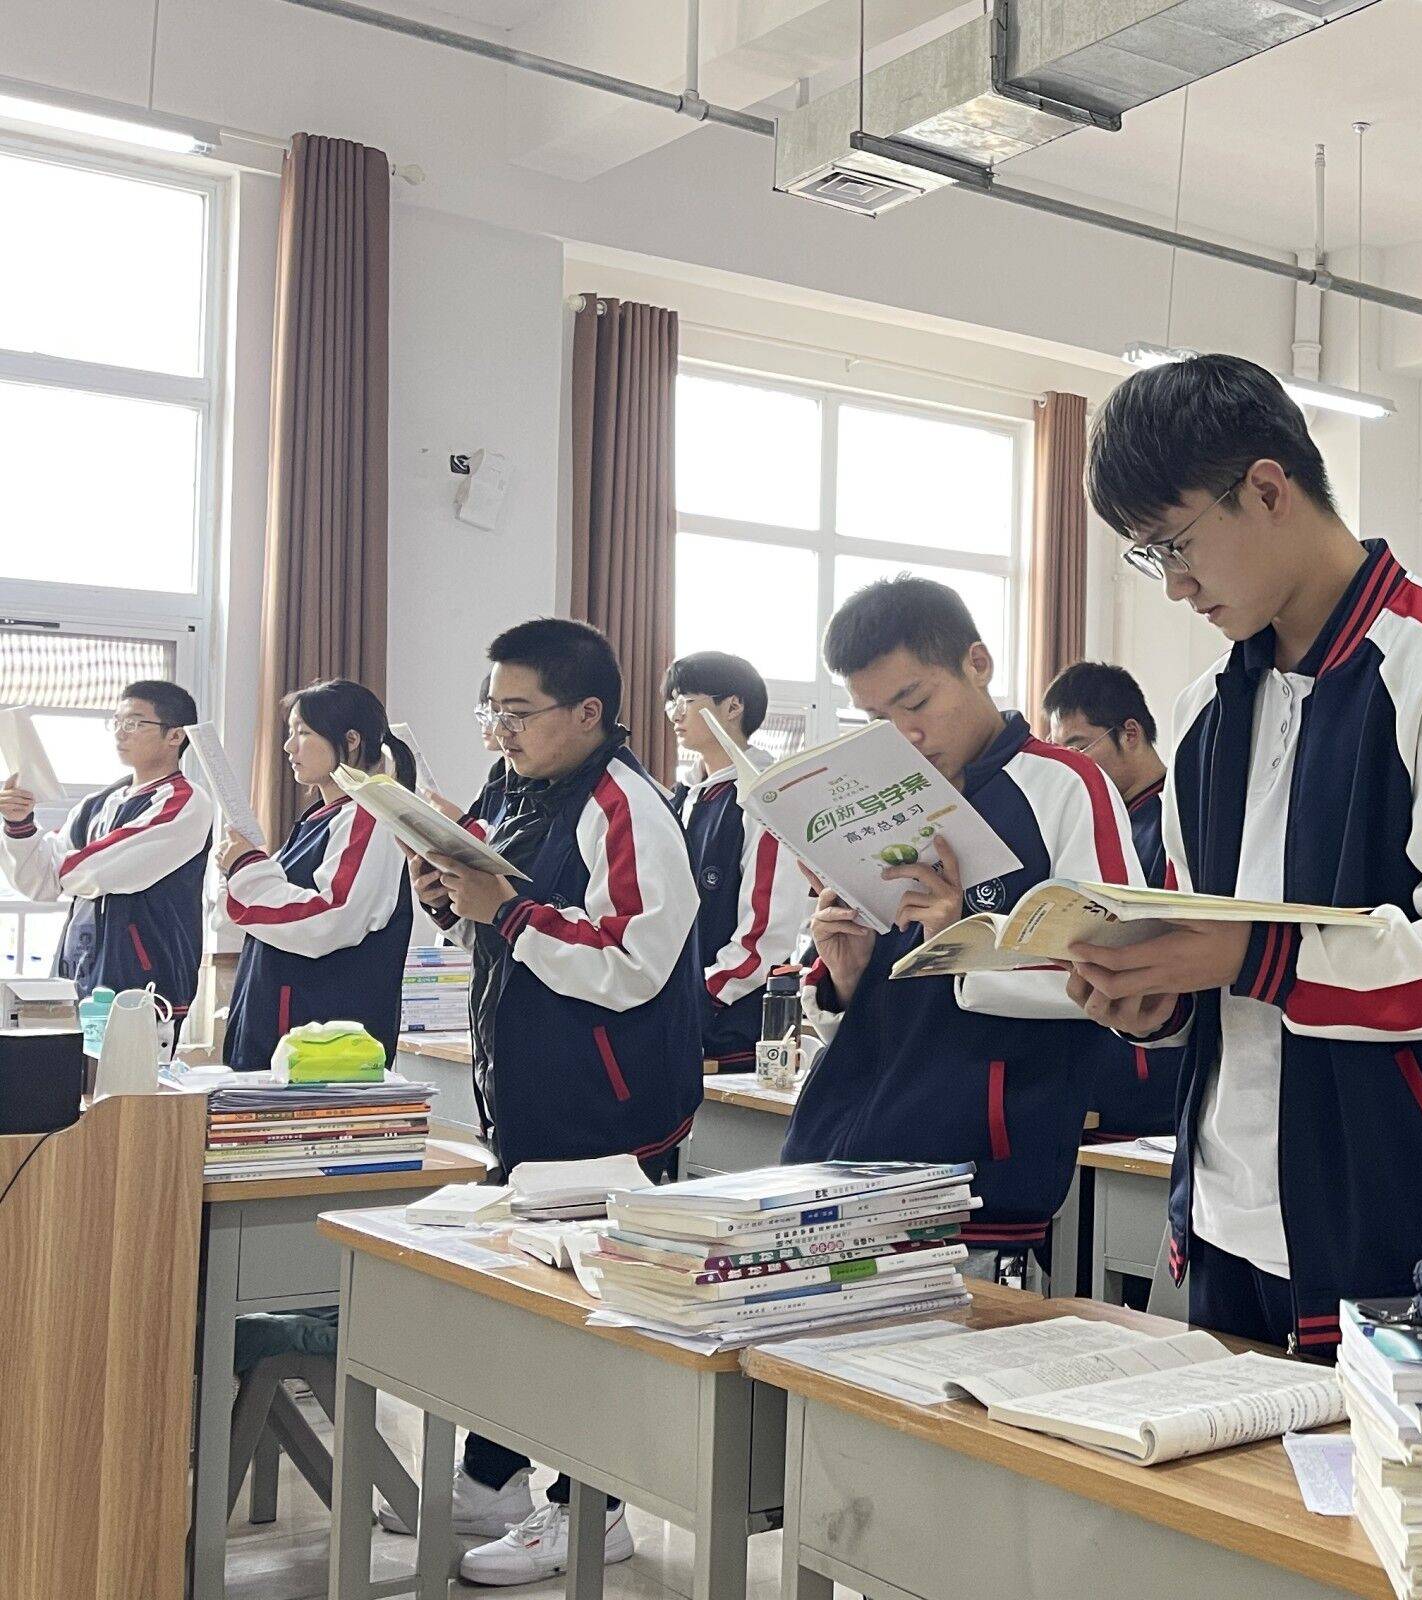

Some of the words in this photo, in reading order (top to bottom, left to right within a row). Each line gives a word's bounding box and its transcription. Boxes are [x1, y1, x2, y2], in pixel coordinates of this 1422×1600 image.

[842, 803, 924, 844] 高考总复习
